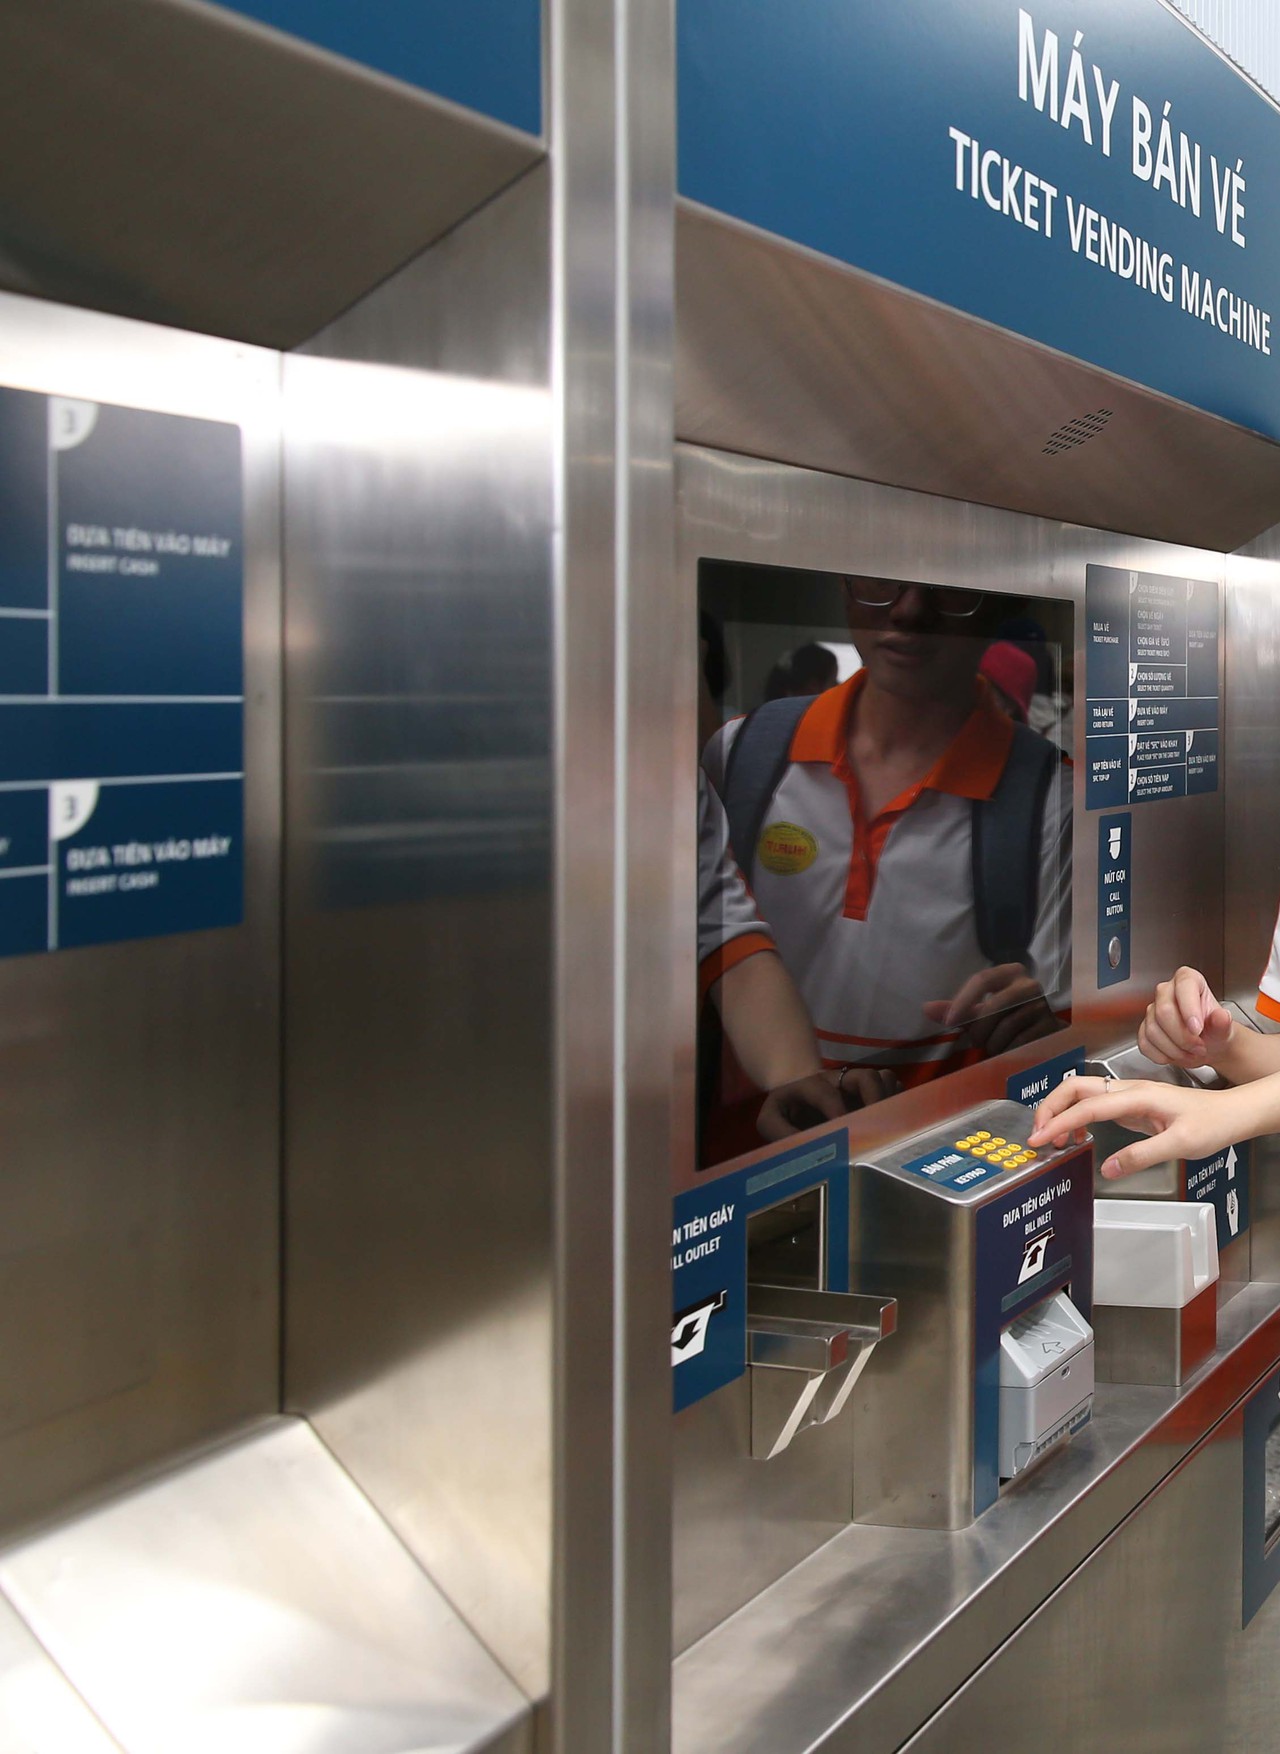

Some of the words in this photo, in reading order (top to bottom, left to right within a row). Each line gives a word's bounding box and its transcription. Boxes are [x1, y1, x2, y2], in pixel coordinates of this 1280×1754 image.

[1018, 7, 1120, 157] MÁY
[1132, 95, 1201, 218] BÁN
[1210, 155, 1246, 249] VÉ
[949, 126, 1057, 239] TICKET
[1066, 195, 1173, 303] VENDING
[1181, 264, 1272, 356] MACHINE
[1104, 869, 1115, 884] NÚT
[1116, 869, 1126, 883] GỌI
[1109, 891, 1121, 902] CALL
[1106, 904, 1124, 917] BUTTON
[1021, 1081, 1040, 1100] NHẬN
[1040, 1074, 1049, 1091] VÉ
[953, 1168, 987, 1185] KEYPAD
[1196, 1187, 1206, 1200] COIN
[1207, 1179, 1217, 1193] INLET
[1003, 1208, 1021, 1228] ĐƯA
[1021, 1197, 1038, 1217] TIỀN
[1038, 1187, 1056, 1207] GIẤY
[1056, 1179, 1072, 1197] VÀO
[683, 1216, 707, 1241] TIỀN
[709, 1204, 735, 1230] GIẤY
[1025, 1220, 1037, 1235] BILL
[1037, 1210, 1053, 1228] INLET
[685, 1236, 721, 1265] OUTLET
